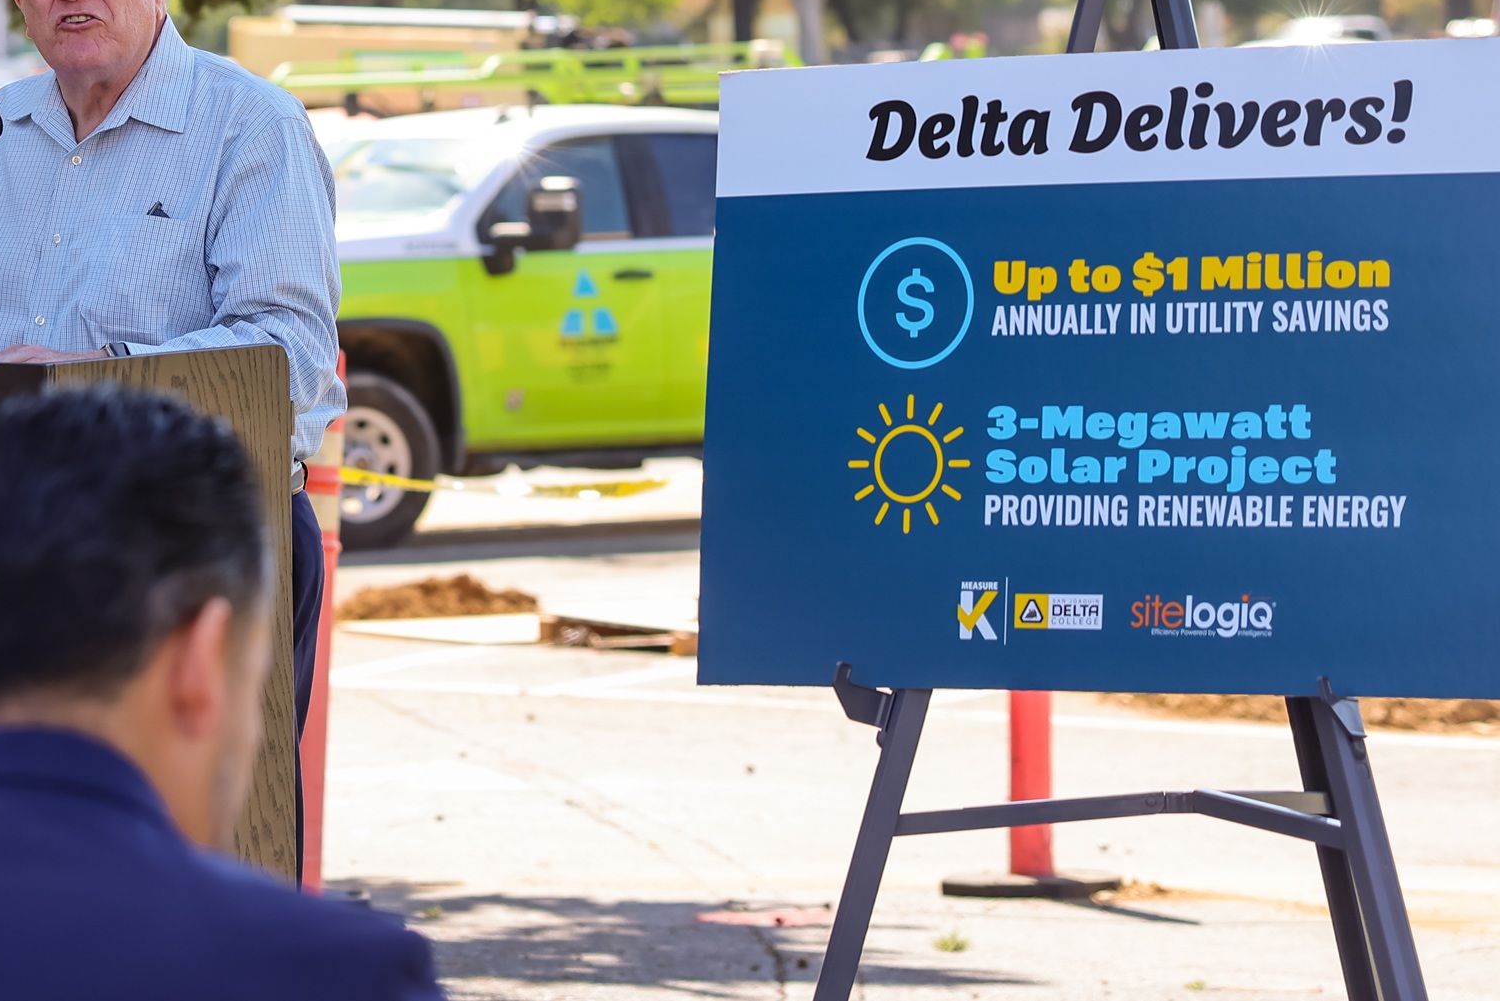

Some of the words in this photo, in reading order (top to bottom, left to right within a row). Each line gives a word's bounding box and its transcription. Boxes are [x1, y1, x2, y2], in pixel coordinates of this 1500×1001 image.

[866, 95, 1050, 162] Delta
[1068, 79, 1414, 156] Delivers!
[994, 261, 1058, 301] Up
[1069, 257, 1123, 294] to
[1131, 251, 1190, 296] $1
[1202, 251, 1390, 290] Million
[990, 303, 1122, 337] ANNUALLY
[1129, 302, 1156, 334] IN
[1165, 300, 1263, 334] UTILITY
[1271, 298, 1389, 332] SAVINGS
[986, 403, 1312, 449] 3-Megawatt
[985, 449, 1128, 485] Solar
[1138, 447, 1338, 493] Project
[984, 494, 1128, 528] PROVIDING
[1137, 494, 1294, 528] RENEWABLE
[1302, 495, 1407, 529] ENERGY
[961, 581, 998, 590] MEASURE
[957, 591, 998, 640] K
[1051, 617, 1099, 626] COLLEGE
[1052, 604, 1099, 617] DELTA
[1208, 629, 1217, 638] by
